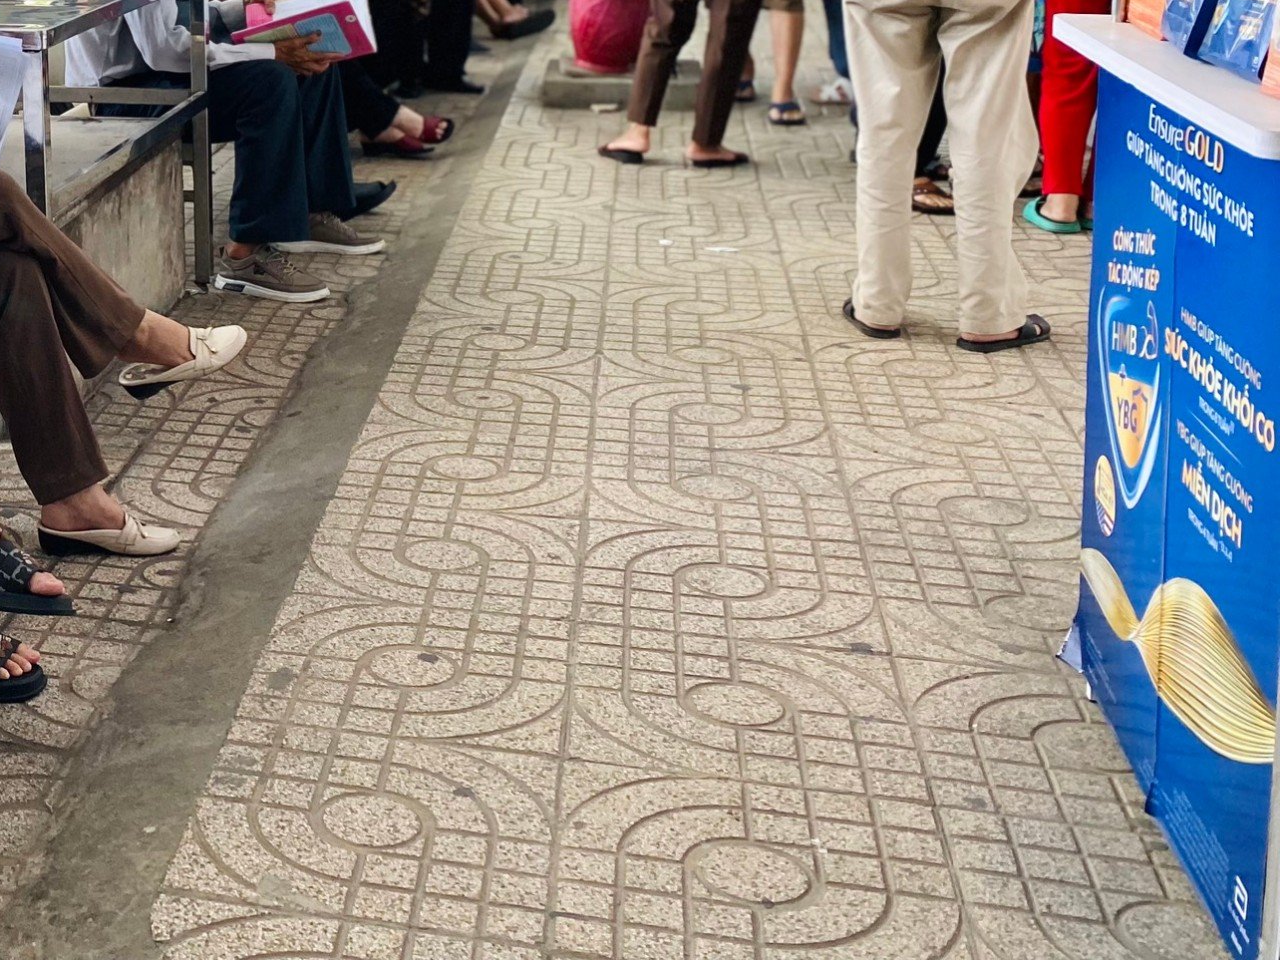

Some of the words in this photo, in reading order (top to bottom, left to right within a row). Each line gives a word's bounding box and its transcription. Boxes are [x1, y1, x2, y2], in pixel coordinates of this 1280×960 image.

[1148, 102, 1183, 152] Ensure
[1185, 125, 1224, 174] GOLD
[1126, 129, 1144, 159] GIÚP
[1145, 142, 1165, 177] TĂNG
[1166, 159, 1201, 201] CƯỜNG
[1203, 182, 1223, 215] SỨC
[1224, 196, 1255, 238] KHỎE
[1150, 179, 1178, 222] TRONG
[1180, 204, 1187, 227] 8
[1189, 207, 1217, 248] TUẦN
[1113, 225, 1134, 253] CÔNG
[1135, 228, 1156, 256] THỨC
[1108, 257, 1121, 284] TÁC
[1144, 263, 1160, 291] KÉP
[1112, 320, 1137, 356] HMB
[1197, 320, 1215, 345] GIÚP
[1215, 333, 1234, 364] TĂNG
[1117, 396, 1138, 433] YBG
[1164, 326, 1188, 369] SỨC
[1189, 347, 1222, 402] KHỎE
[1223, 377, 1255, 434] KHỐI
[1256, 410, 1275, 453] CƠ
[1190, 431, 1206, 460] GIÚP
[1206, 448, 1225, 482] TĂNG
[1181, 457, 1211, 513] MIỄN
[1212, 489, 1242, 549] DỊCH
